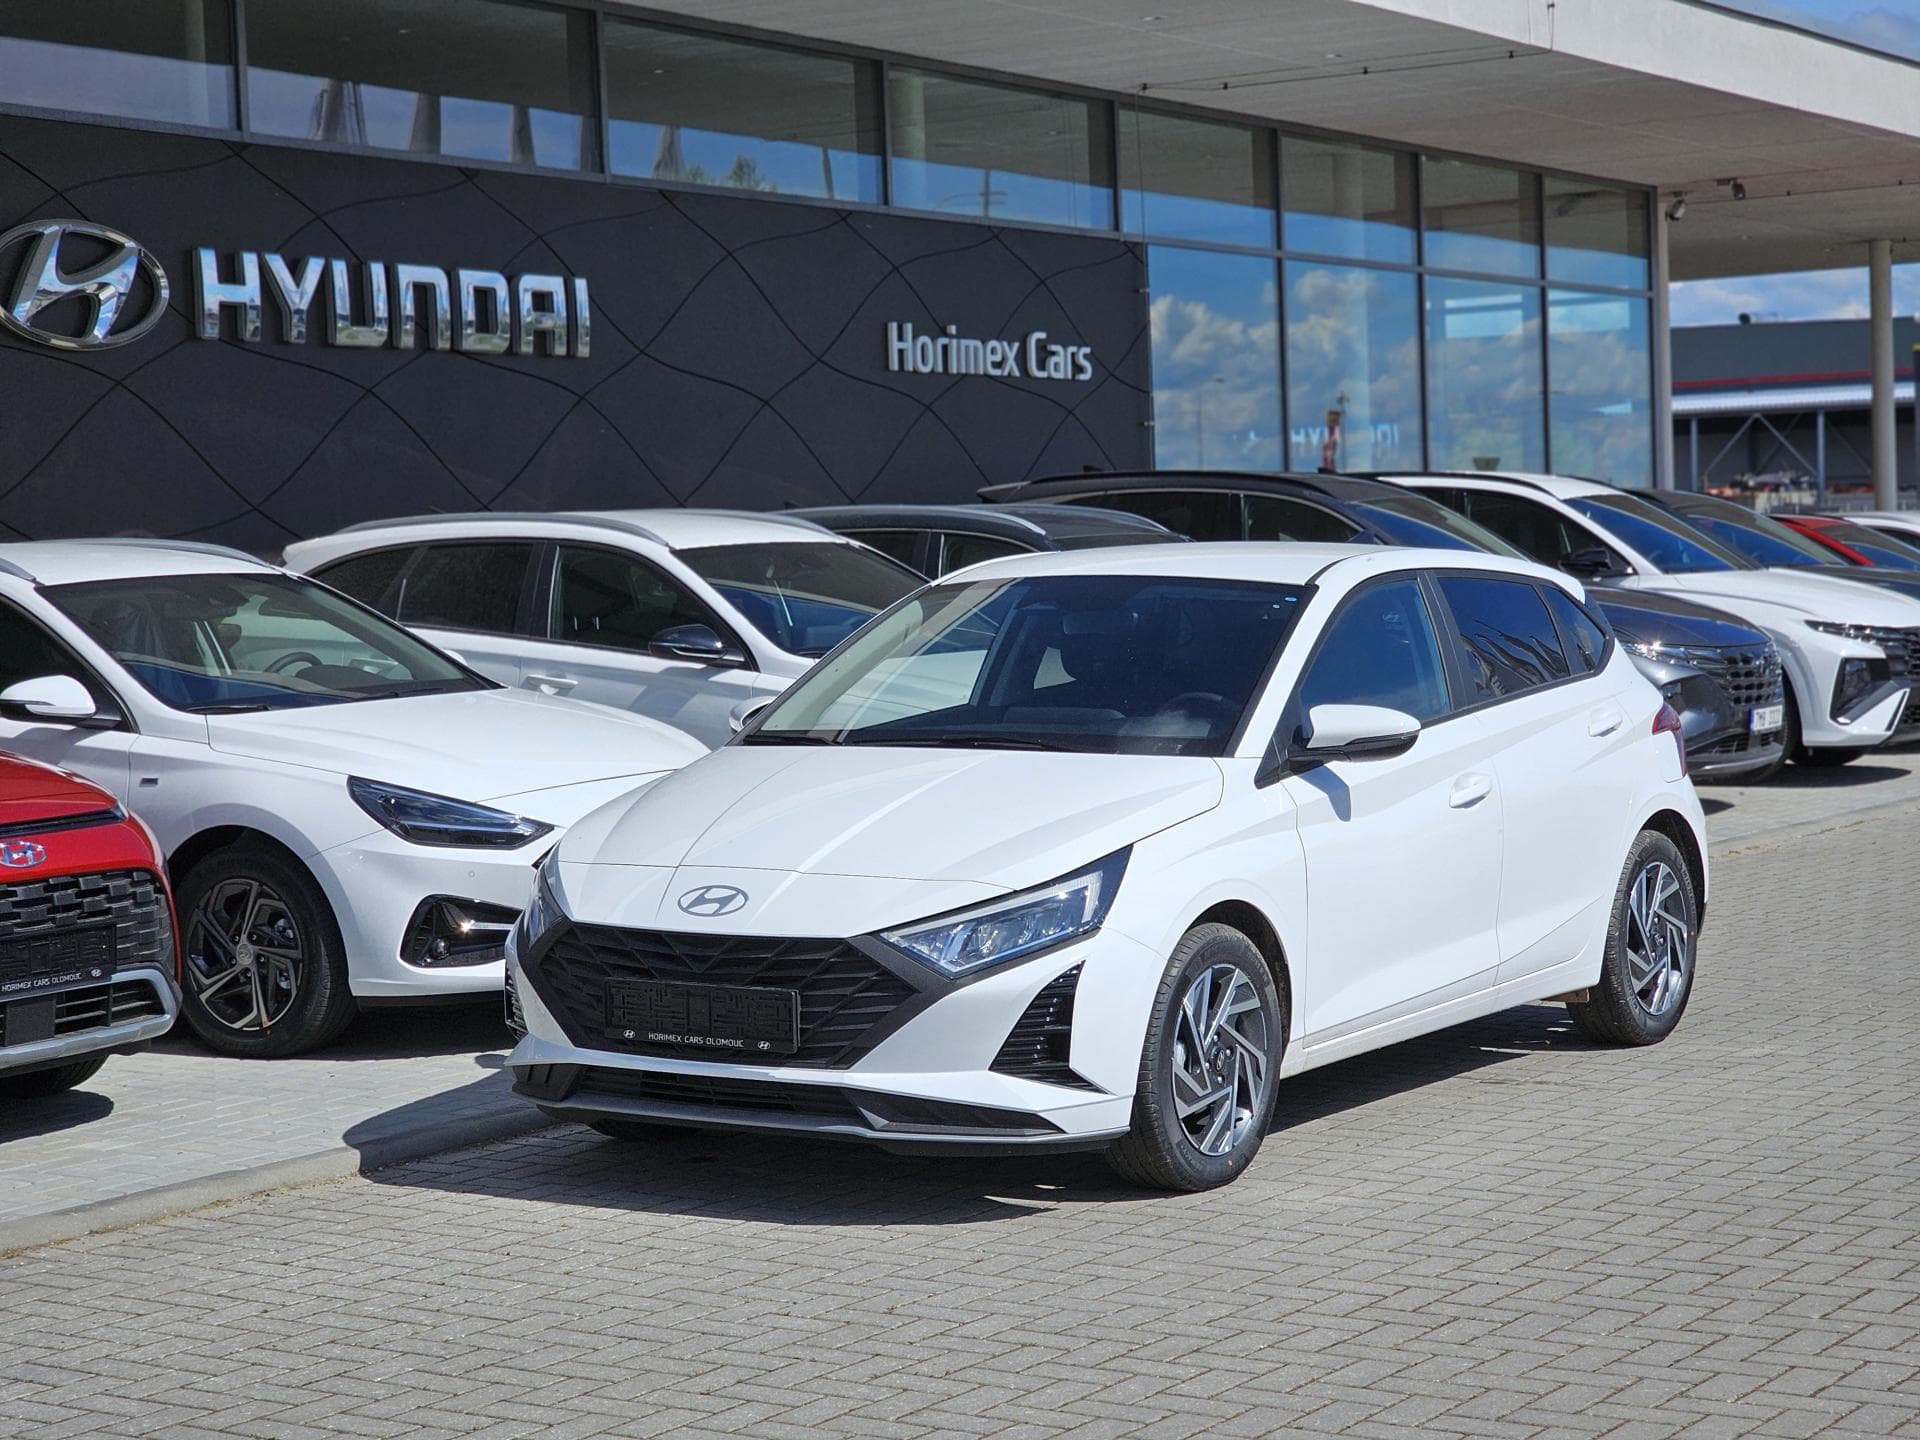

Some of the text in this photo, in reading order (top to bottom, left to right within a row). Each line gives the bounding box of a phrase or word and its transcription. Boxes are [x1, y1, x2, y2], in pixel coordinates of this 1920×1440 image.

[194, 247, 592, 358] HYUNDAI
[886, 321, 1093, 381] Horimex Cars
[1, 973, 82, 992] HORIMEX CARS OLOMOUC
[648, 1032, 744, 1047] HORIMEX CARS OLOMOUC
